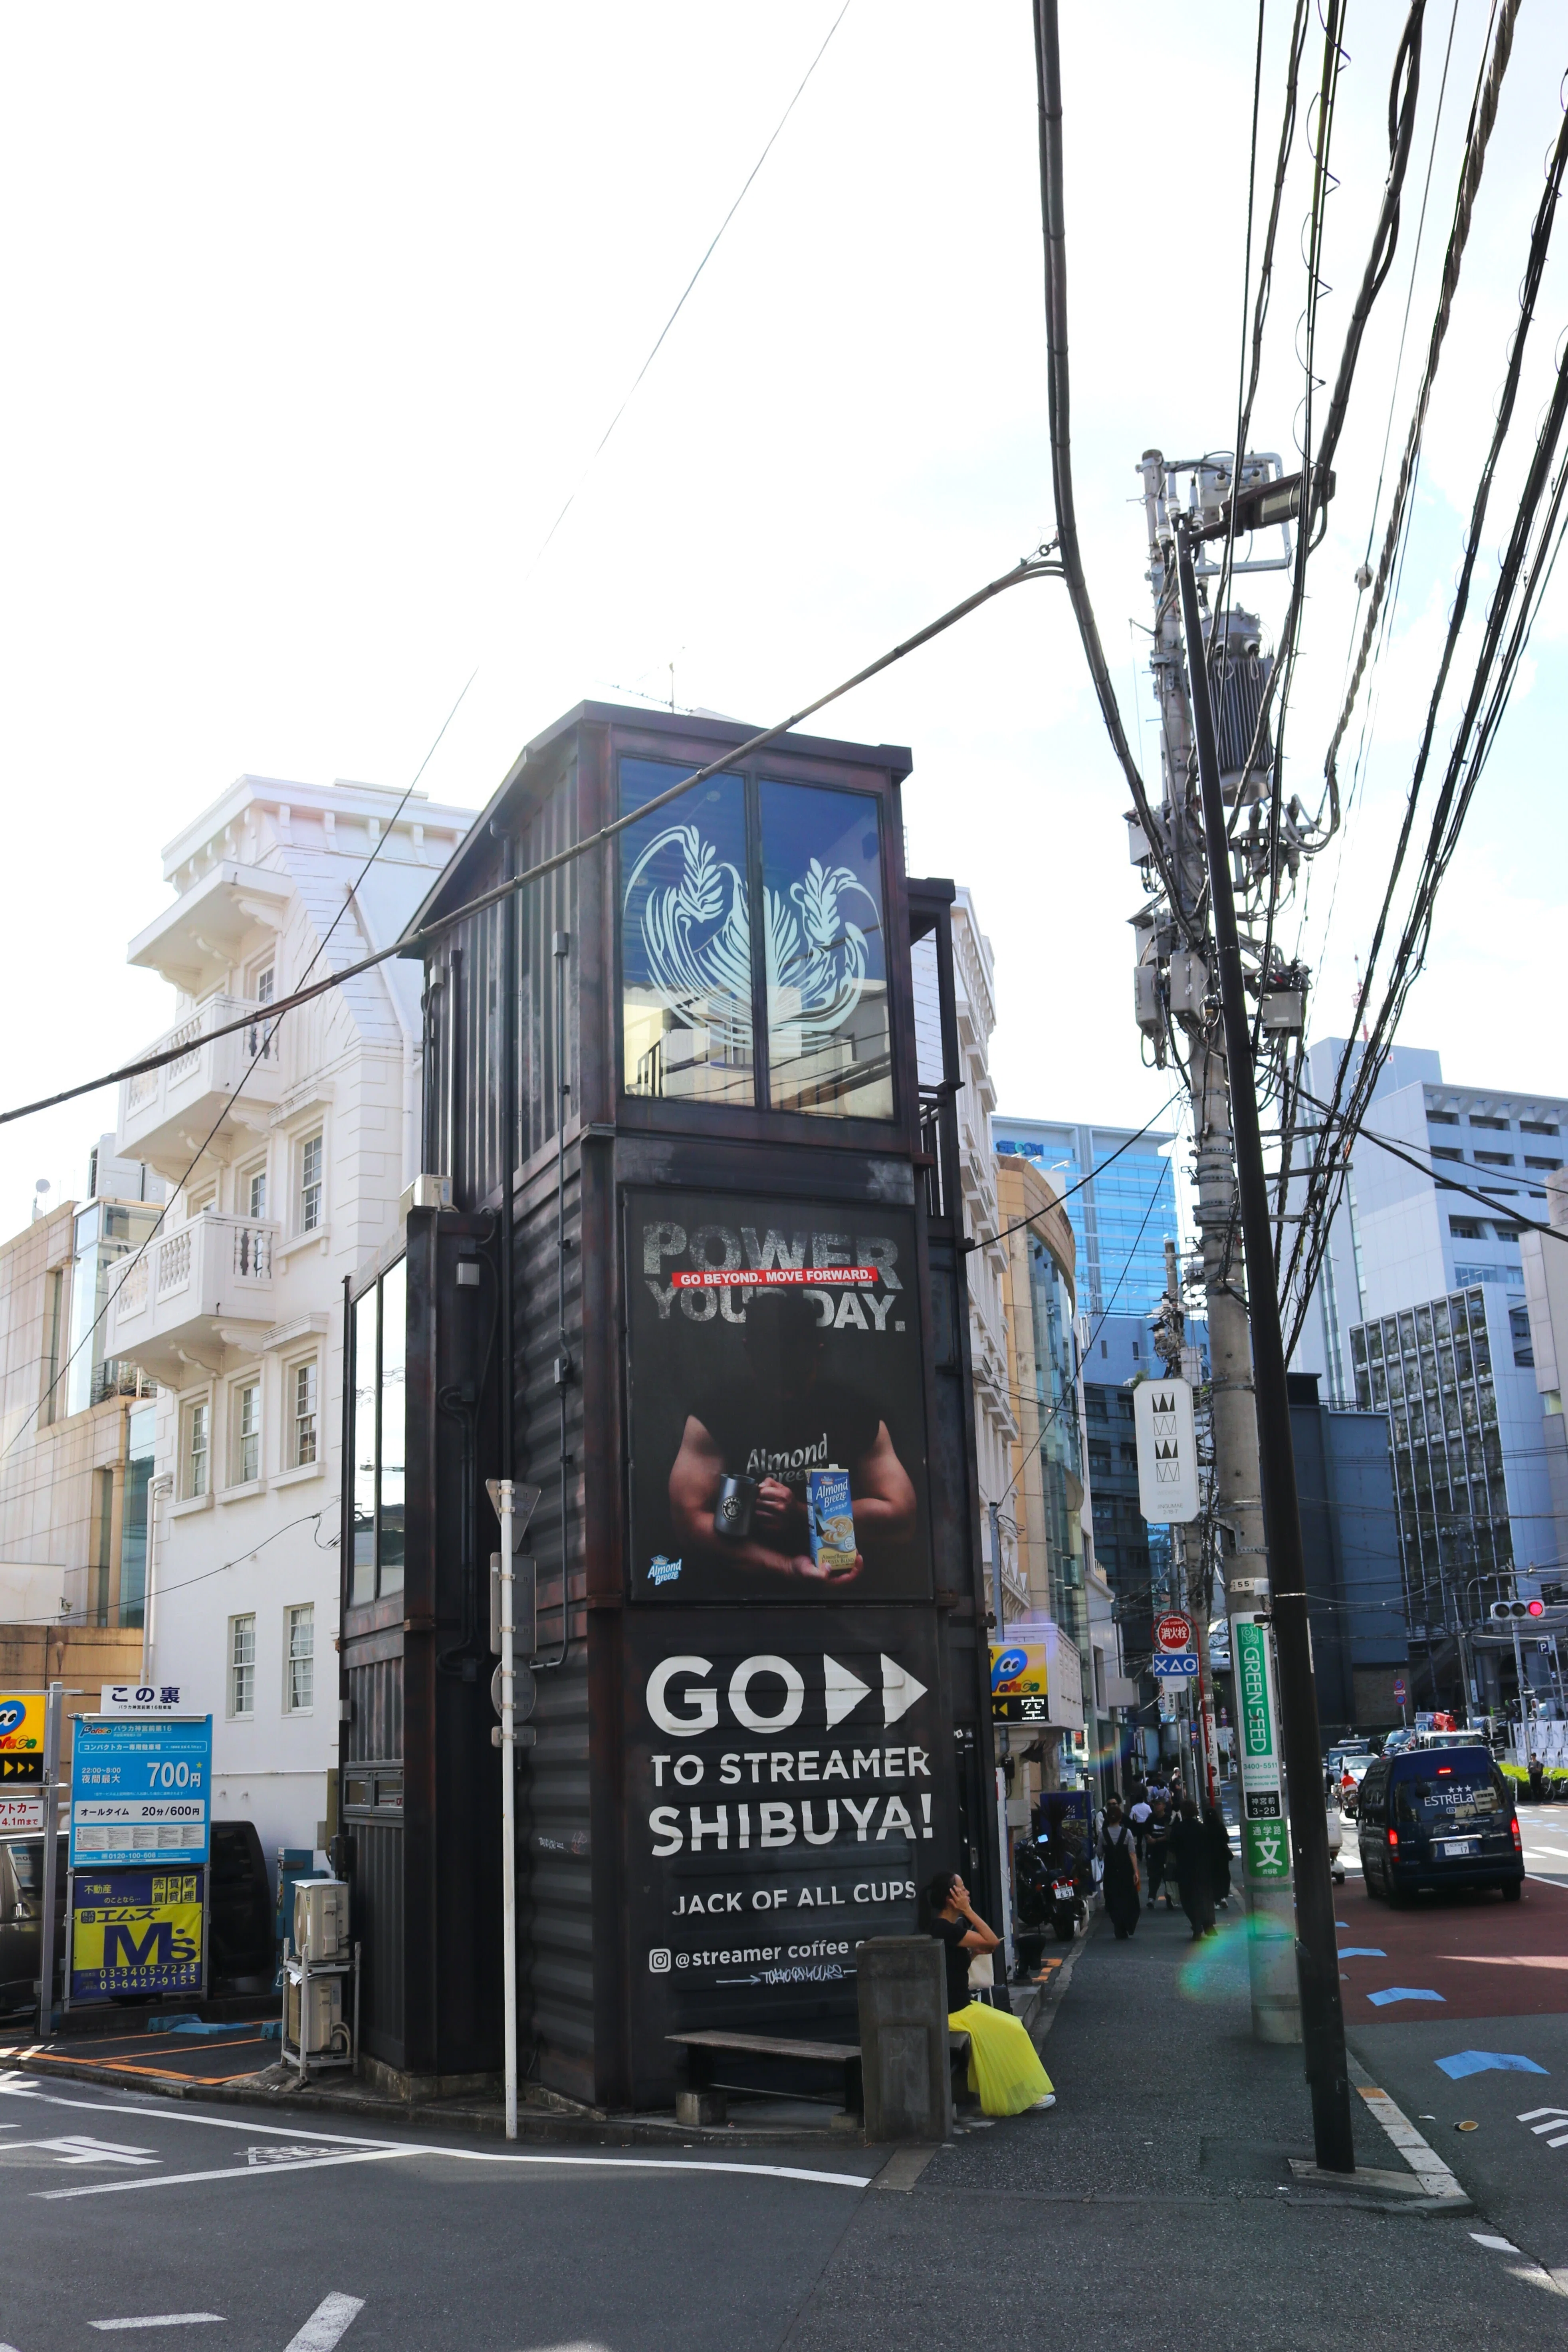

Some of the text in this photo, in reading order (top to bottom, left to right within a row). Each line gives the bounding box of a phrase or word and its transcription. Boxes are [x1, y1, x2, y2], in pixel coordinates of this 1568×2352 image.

[642, 1221, 904, 1290] POWER
[680, 1269, 872, 1285] GO BEYOND. MOVE FORWARD.
[644, 1280, 906, 1332] YOU DAY.
[746, 1433, 828, 1475] Almond
[816, 1478, 848, 1500] Almond
[824, 1491, 846, 1508] Breeze
[647, 1558, 682, 1579] Almond
[655, 1571, 679, 1586] Breeze
[1161, 1626, 1187, 1640] 消火栓
[1540, 1643, 1546, 1652] P
[1243, 1647, 1263, 1705] GREEN
[111, 1686, 180, 1704] この裏
[646, 1654, 805, 1737] GO
[1021, 1696, 1045, 1720] 空
[1248, 1707, 1267, 1752] SEED
[147, 1761, 201, 1788] 700円
[650, 1746, 932, 1787] TO STREAMER
[81, 1775, 121, 1784] 夜間最大
[80, 1806, 200, 1816] オールタイム 20分/600円
[1251, 1797, 1275, 1805] 神宮前
[1, 1817, 38, 1826] 4.1mまで
[648, 1793, 934, 1857] SHIBUYA!
[1252, 1826, 1281, 1836] 通学路
[1255, 1836, 1283, 1867] 文
[84, 1884, 112, 1894] 不動産
[153, 1879, 165, 1903] 売買
[168, 1878, 179, 1902] 賃貸
[184, 1877, 195, 1901] 管理
[672, 1881, 916, 1916] JACK OF ALL CUPS
[97, 1907, 161, 1923] エムズ
[675, 1947, 782, 1969] @streamer
[787, 1940, 849, 1959] coffee
